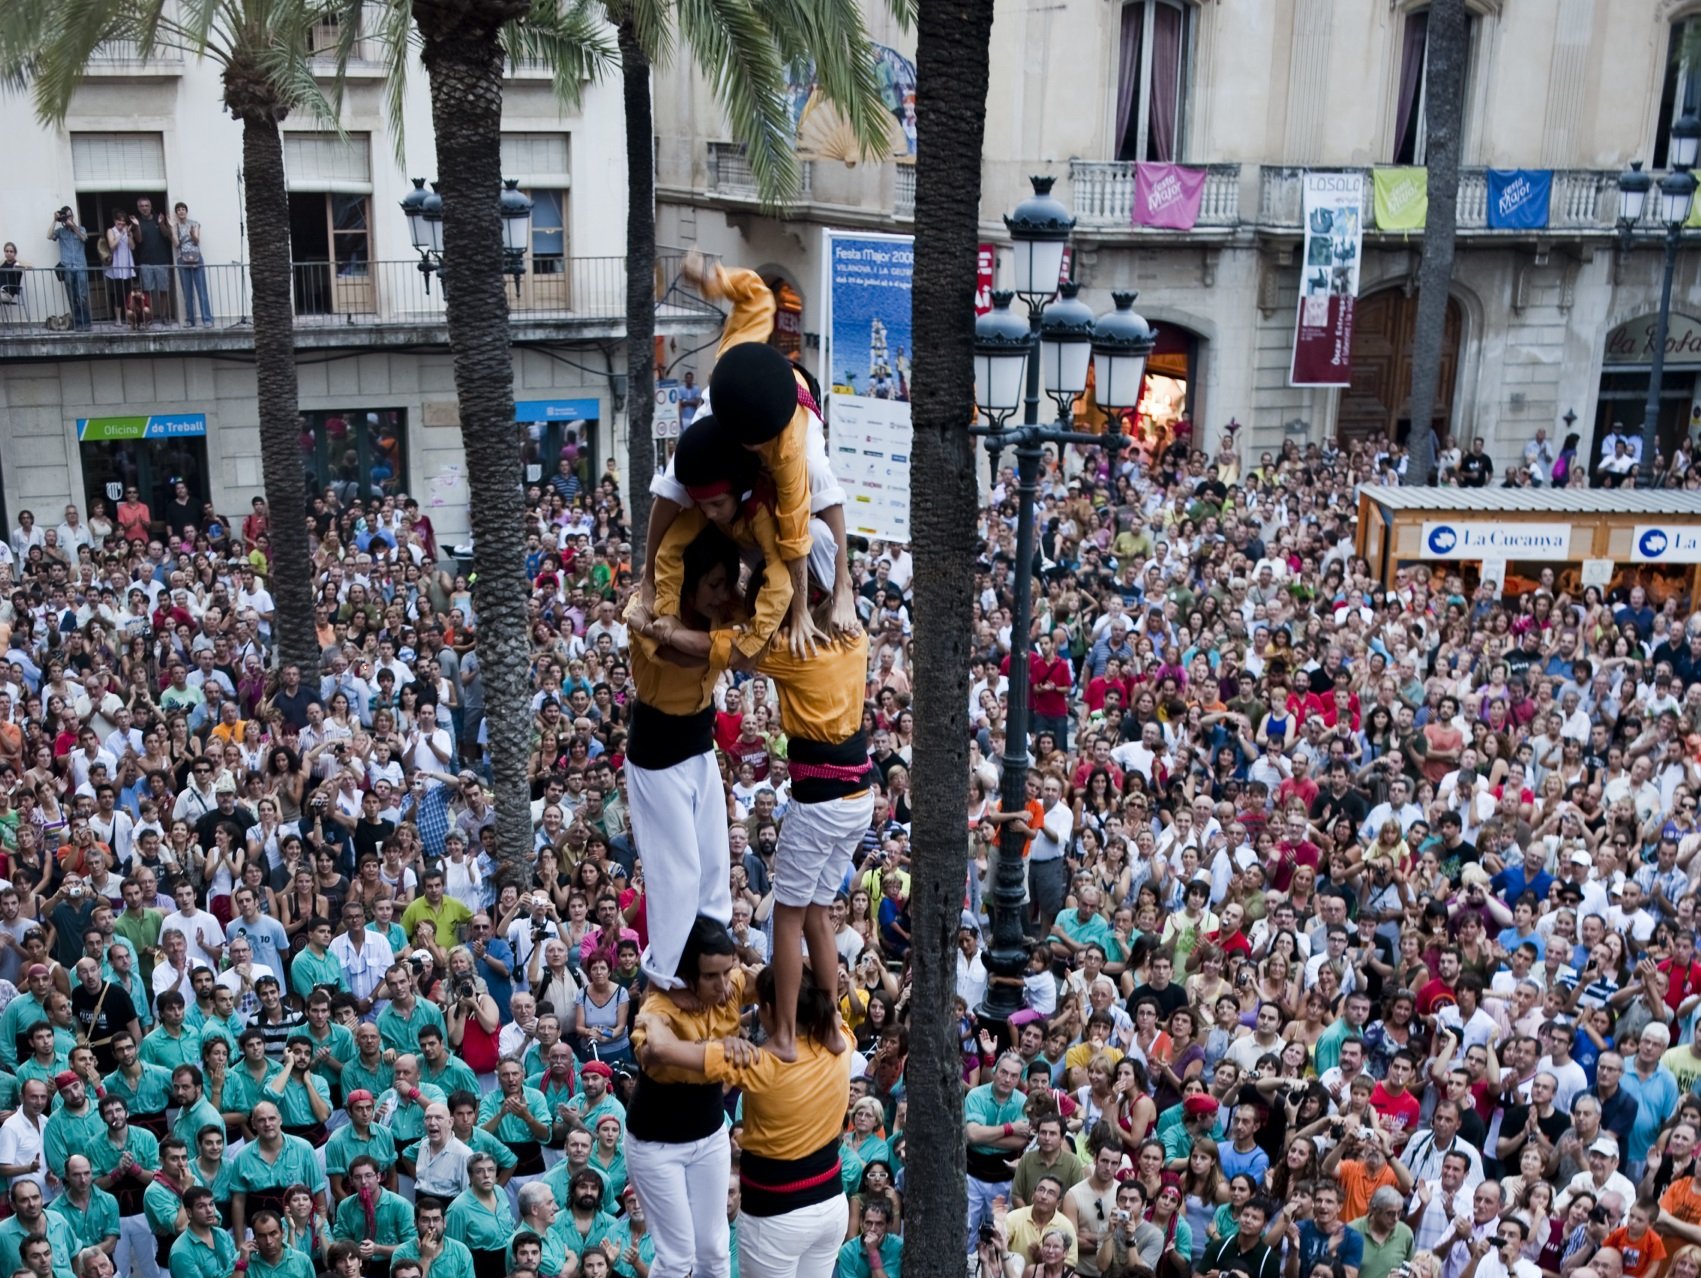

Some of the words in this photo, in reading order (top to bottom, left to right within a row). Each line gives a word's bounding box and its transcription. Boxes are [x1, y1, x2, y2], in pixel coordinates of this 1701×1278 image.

[835, 247, 861, 260] Festa
[863, 248, 891, 264] Major
[104, 424, 138, 435] Oficina
[152, 423, 164, 433] de
[166, 421, 204, 432] Treball
[1464, 530, 1486, 547] La
[1490, 529, 1564, 553] Cucanya
[1675, 533, 1697, 549] La
[260, 935, 271, 943] 10
